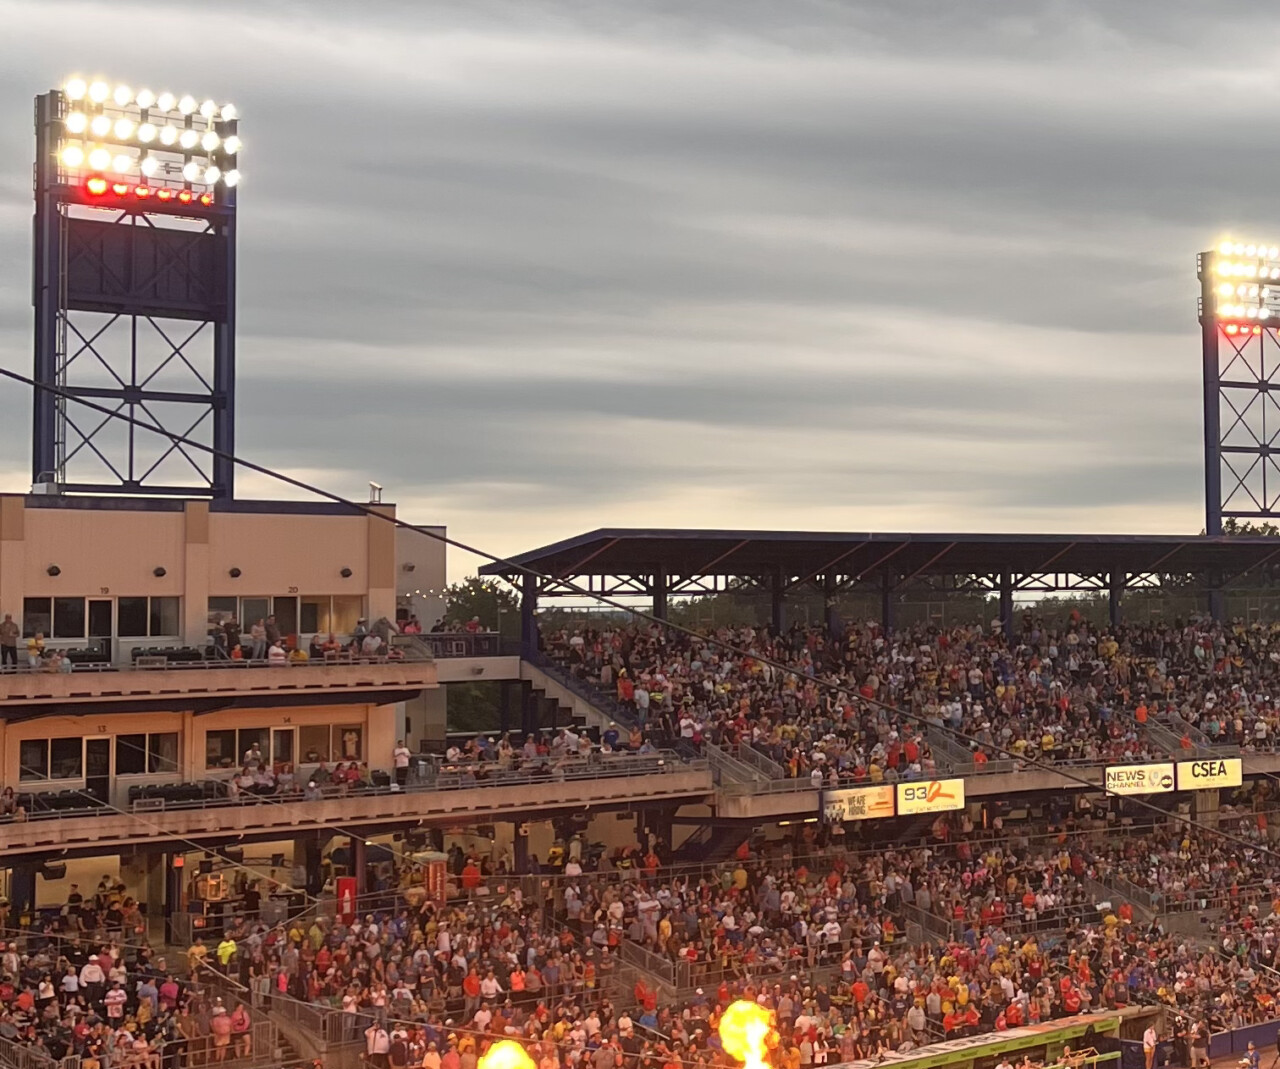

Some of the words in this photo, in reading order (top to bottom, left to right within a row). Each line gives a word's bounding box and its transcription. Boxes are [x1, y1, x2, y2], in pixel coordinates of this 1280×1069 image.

[288, 586, 299, 594] 20
[1192, 761, 1227, 778] CSEA
[1107, 770, 1146, 782] NEWS
[1107, 780, 1146, 789] CHANNEL
